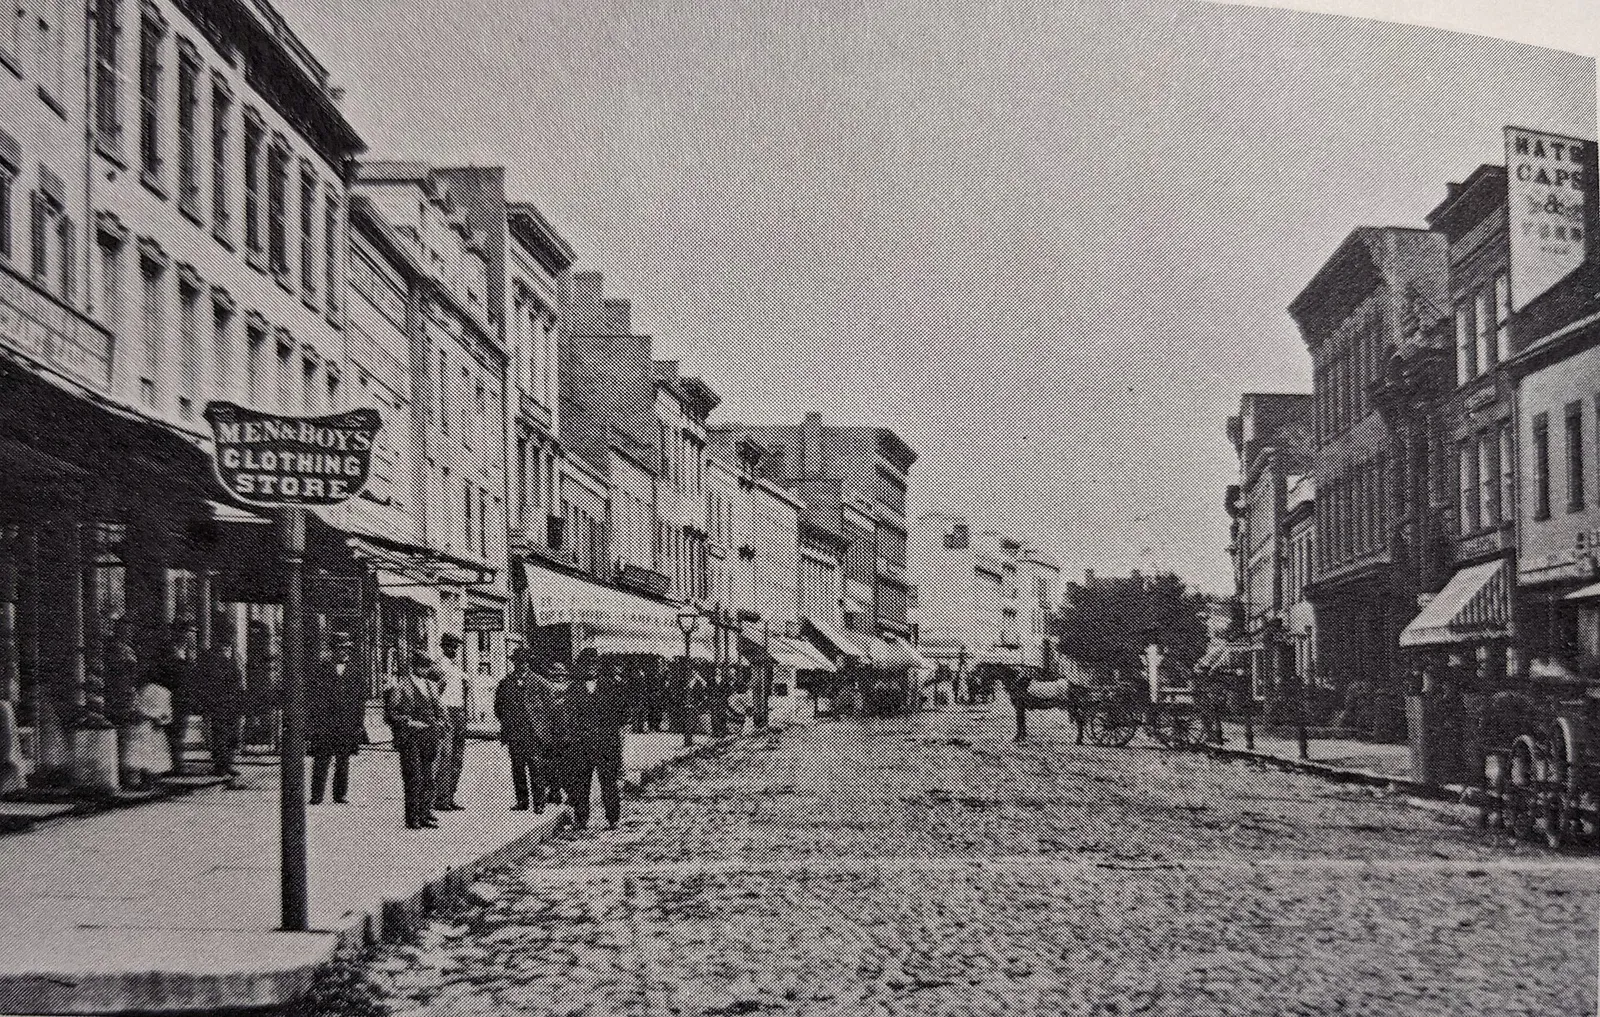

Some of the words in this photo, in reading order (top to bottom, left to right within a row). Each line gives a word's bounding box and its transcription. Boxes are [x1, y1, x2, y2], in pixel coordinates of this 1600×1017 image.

[1516, 163, 1584, 190] CAPS
[223, 448, 361, 476] CLOTHING
[236, 473, 350, 498] STORE
